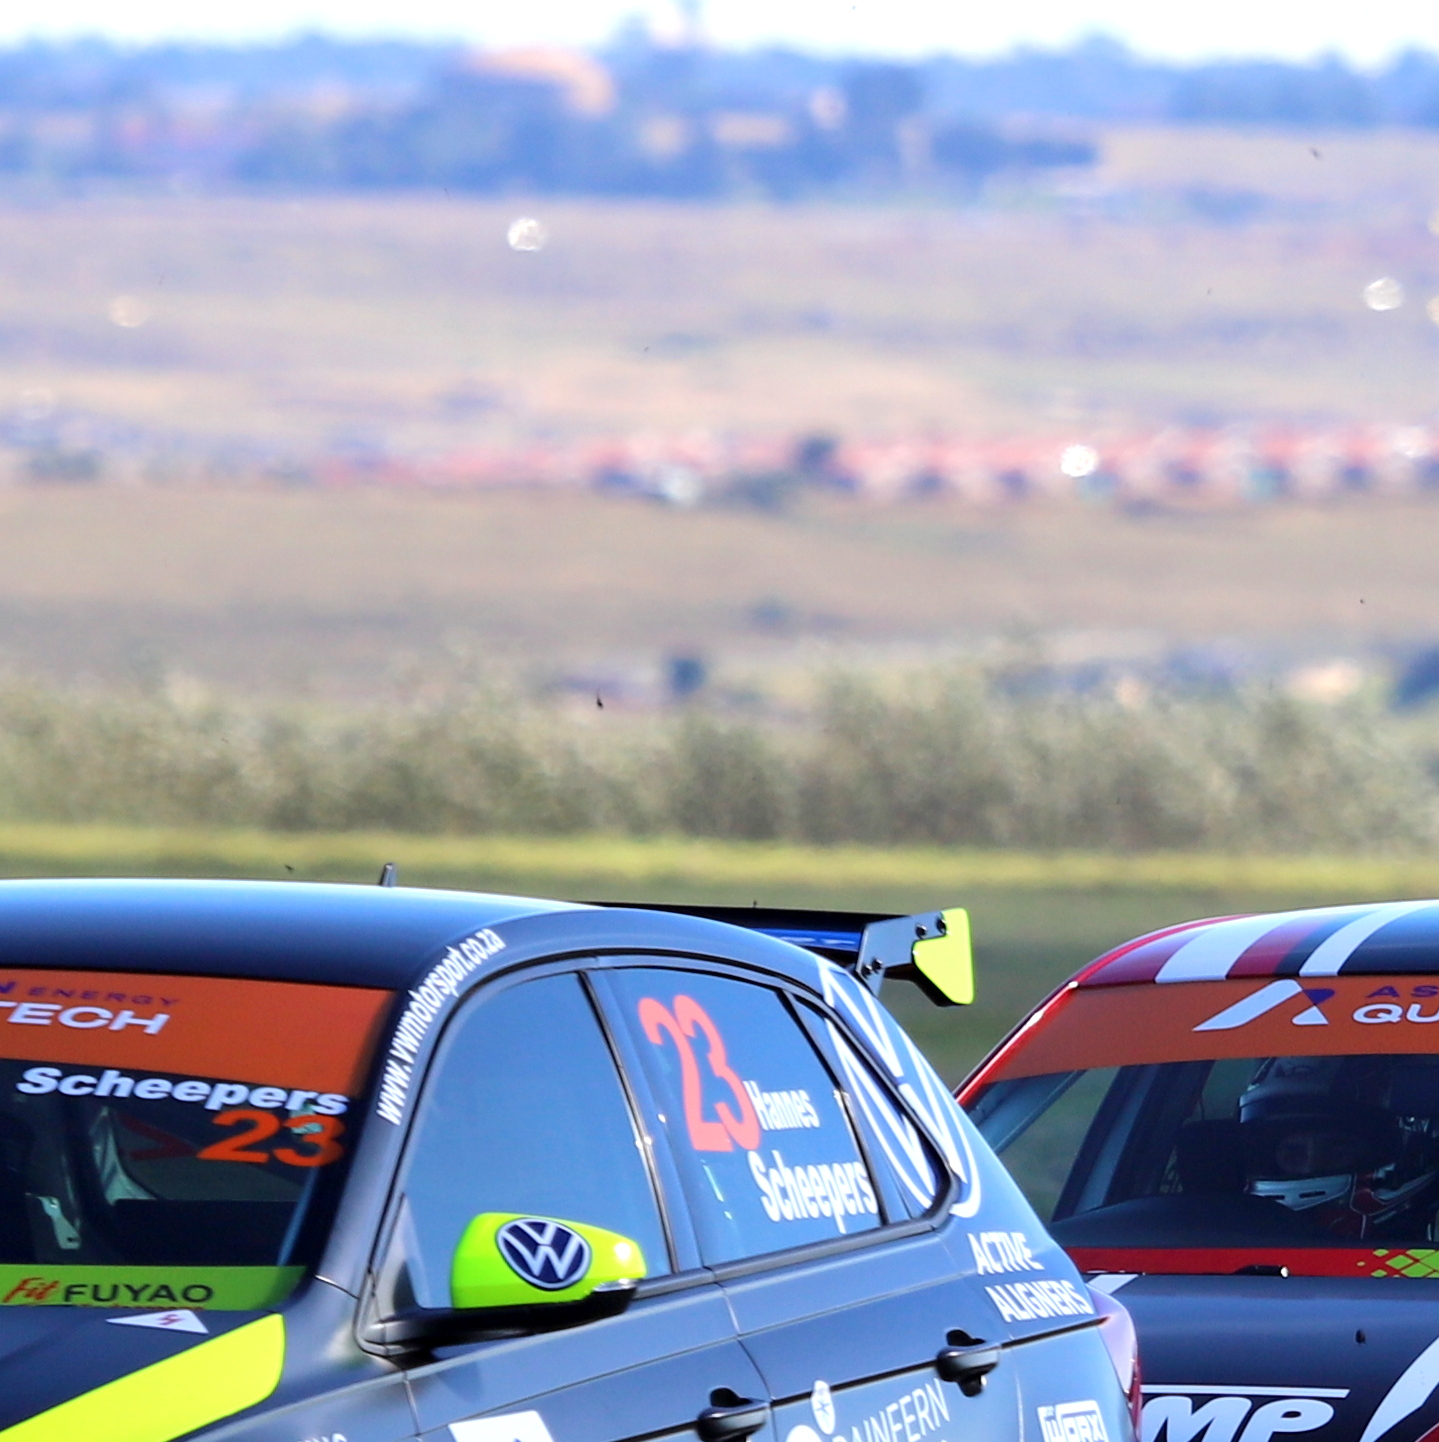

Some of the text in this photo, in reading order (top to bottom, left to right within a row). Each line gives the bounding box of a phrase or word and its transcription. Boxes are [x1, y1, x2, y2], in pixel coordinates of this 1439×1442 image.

[28, 986, 181, 1007] ENERGY
[16, 1067, 349, 1114] Scheepers
[638, 995, 761, 1151] 23
[743, 1081, 820, 1132] Hannes
[197, 1110, 346, 1167] 23
[748, 1150, 878, 1234] Scheepers
[967, 1232, 1044, 1276] ACTIVE
[65, 1284, 214, 1303] FUYAO
[985, 1280, 1094, 1323] ALIGNERS
